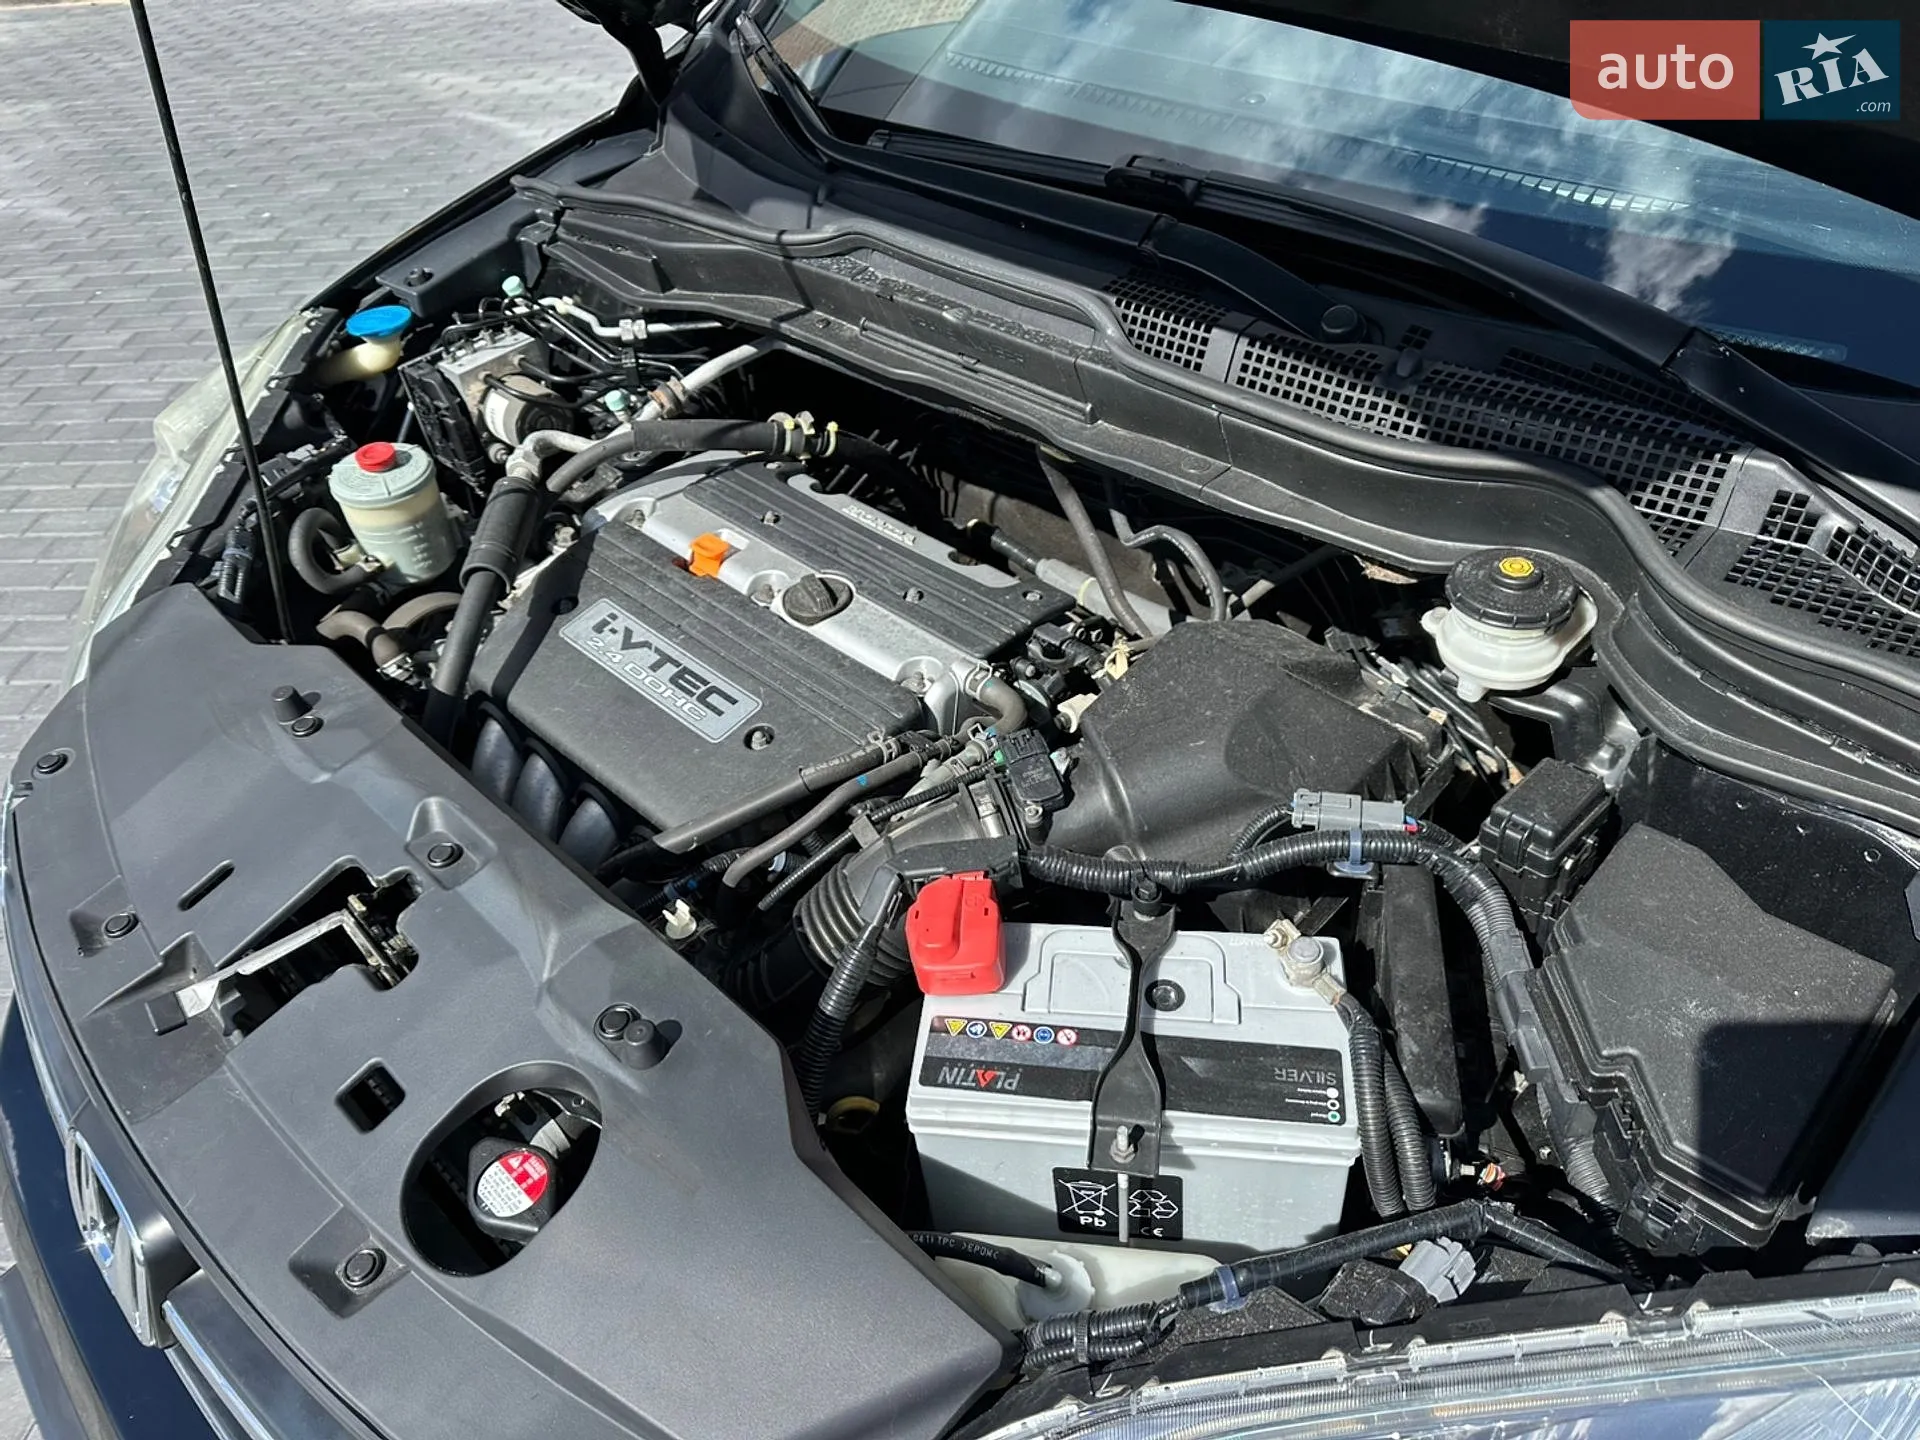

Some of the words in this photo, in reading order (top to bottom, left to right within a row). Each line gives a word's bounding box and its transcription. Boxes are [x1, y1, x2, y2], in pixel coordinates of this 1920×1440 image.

[587, 637, 624, 663] 2.4
[623, 662, 707, 721] DOHC
[937, 1066, 1022, 1091] PLATIN
[1274, 1067, 1337, 1086] SILVER
[1080, 1216, 1107, 1227] Pb
